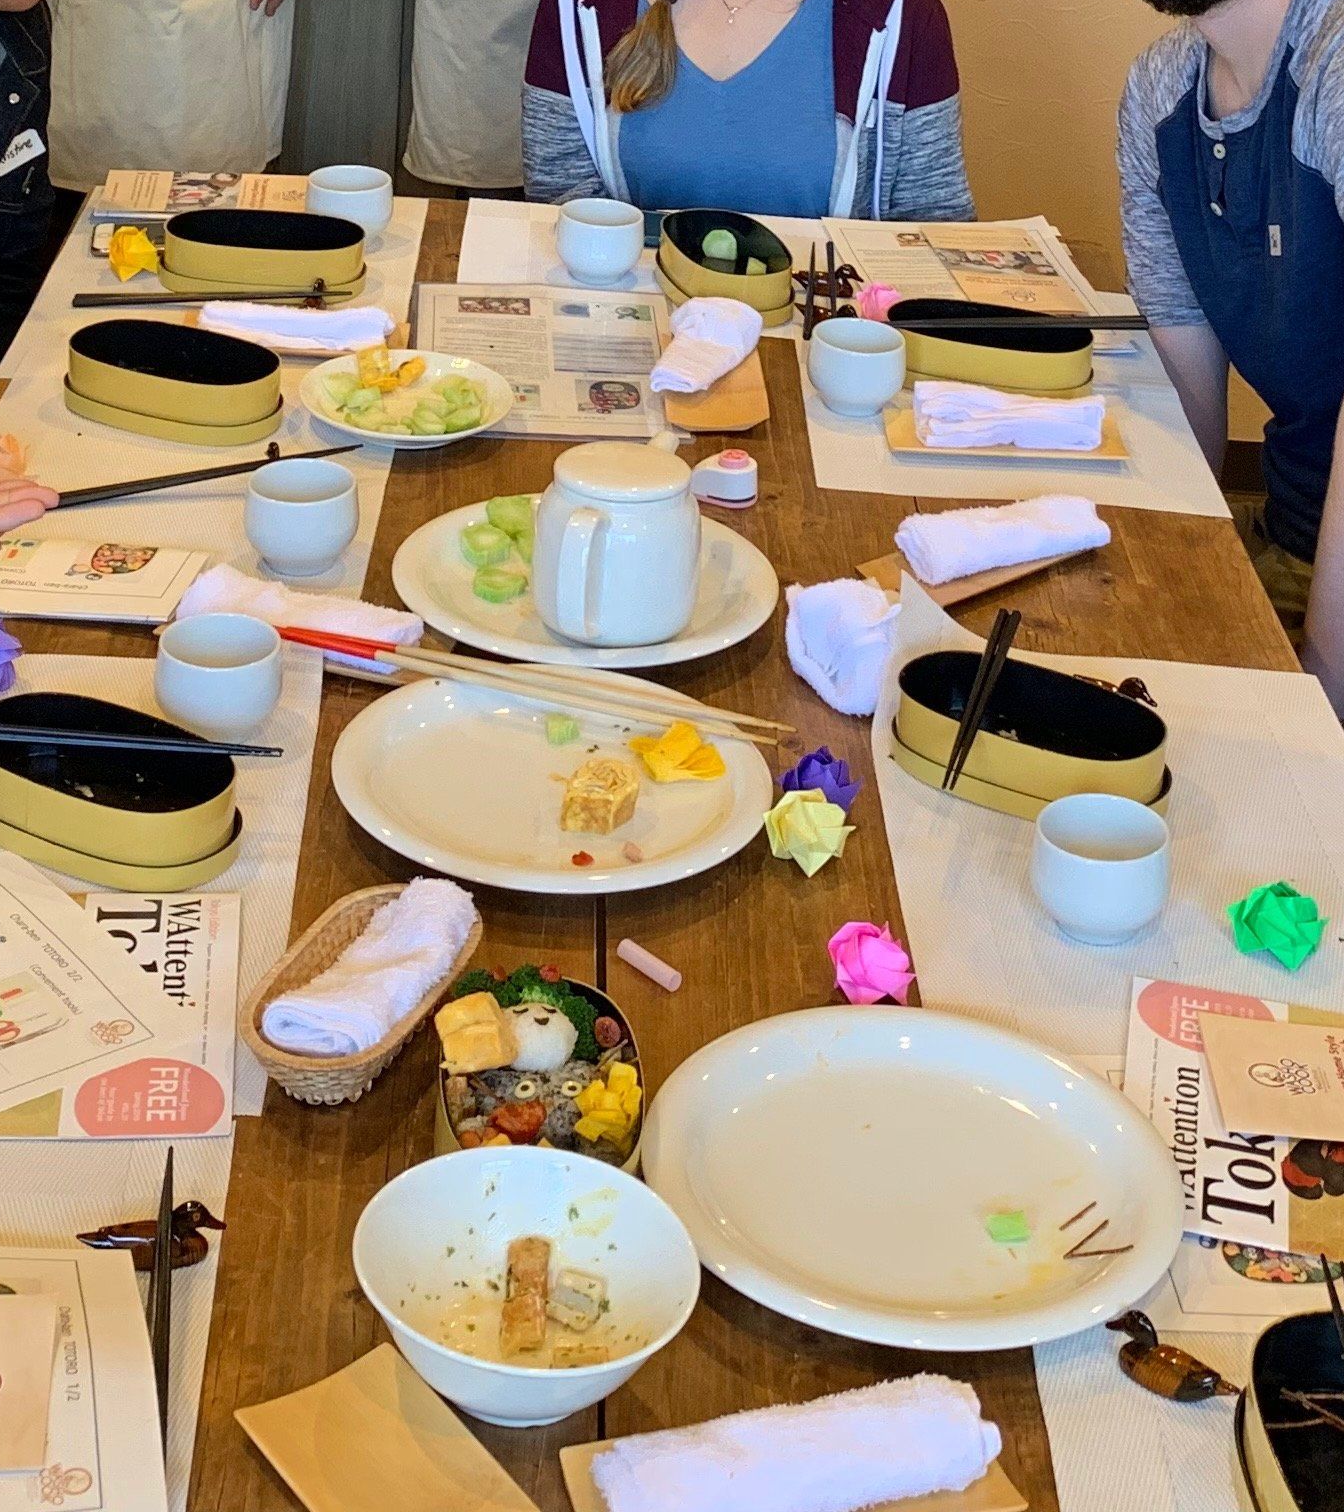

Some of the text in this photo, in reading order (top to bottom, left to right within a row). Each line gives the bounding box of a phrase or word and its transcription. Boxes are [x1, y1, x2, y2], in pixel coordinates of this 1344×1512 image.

[163, 899, 202, 1007] WAttent
[1180, 996, 1210, 1043] FREE
[1323, 1033, 1340, 1056] Style
[146, 1065, 180, 1123] FREE
[1279, 1057, 1303, 1097] WASHO
[1294, 1063, 1316, 1095] COOK
[1164, 1066, 1202, 1210] Attention
[1202, 1130, 1276, 1226] Tok
[66, 1383, 80, 1402] 1/2
